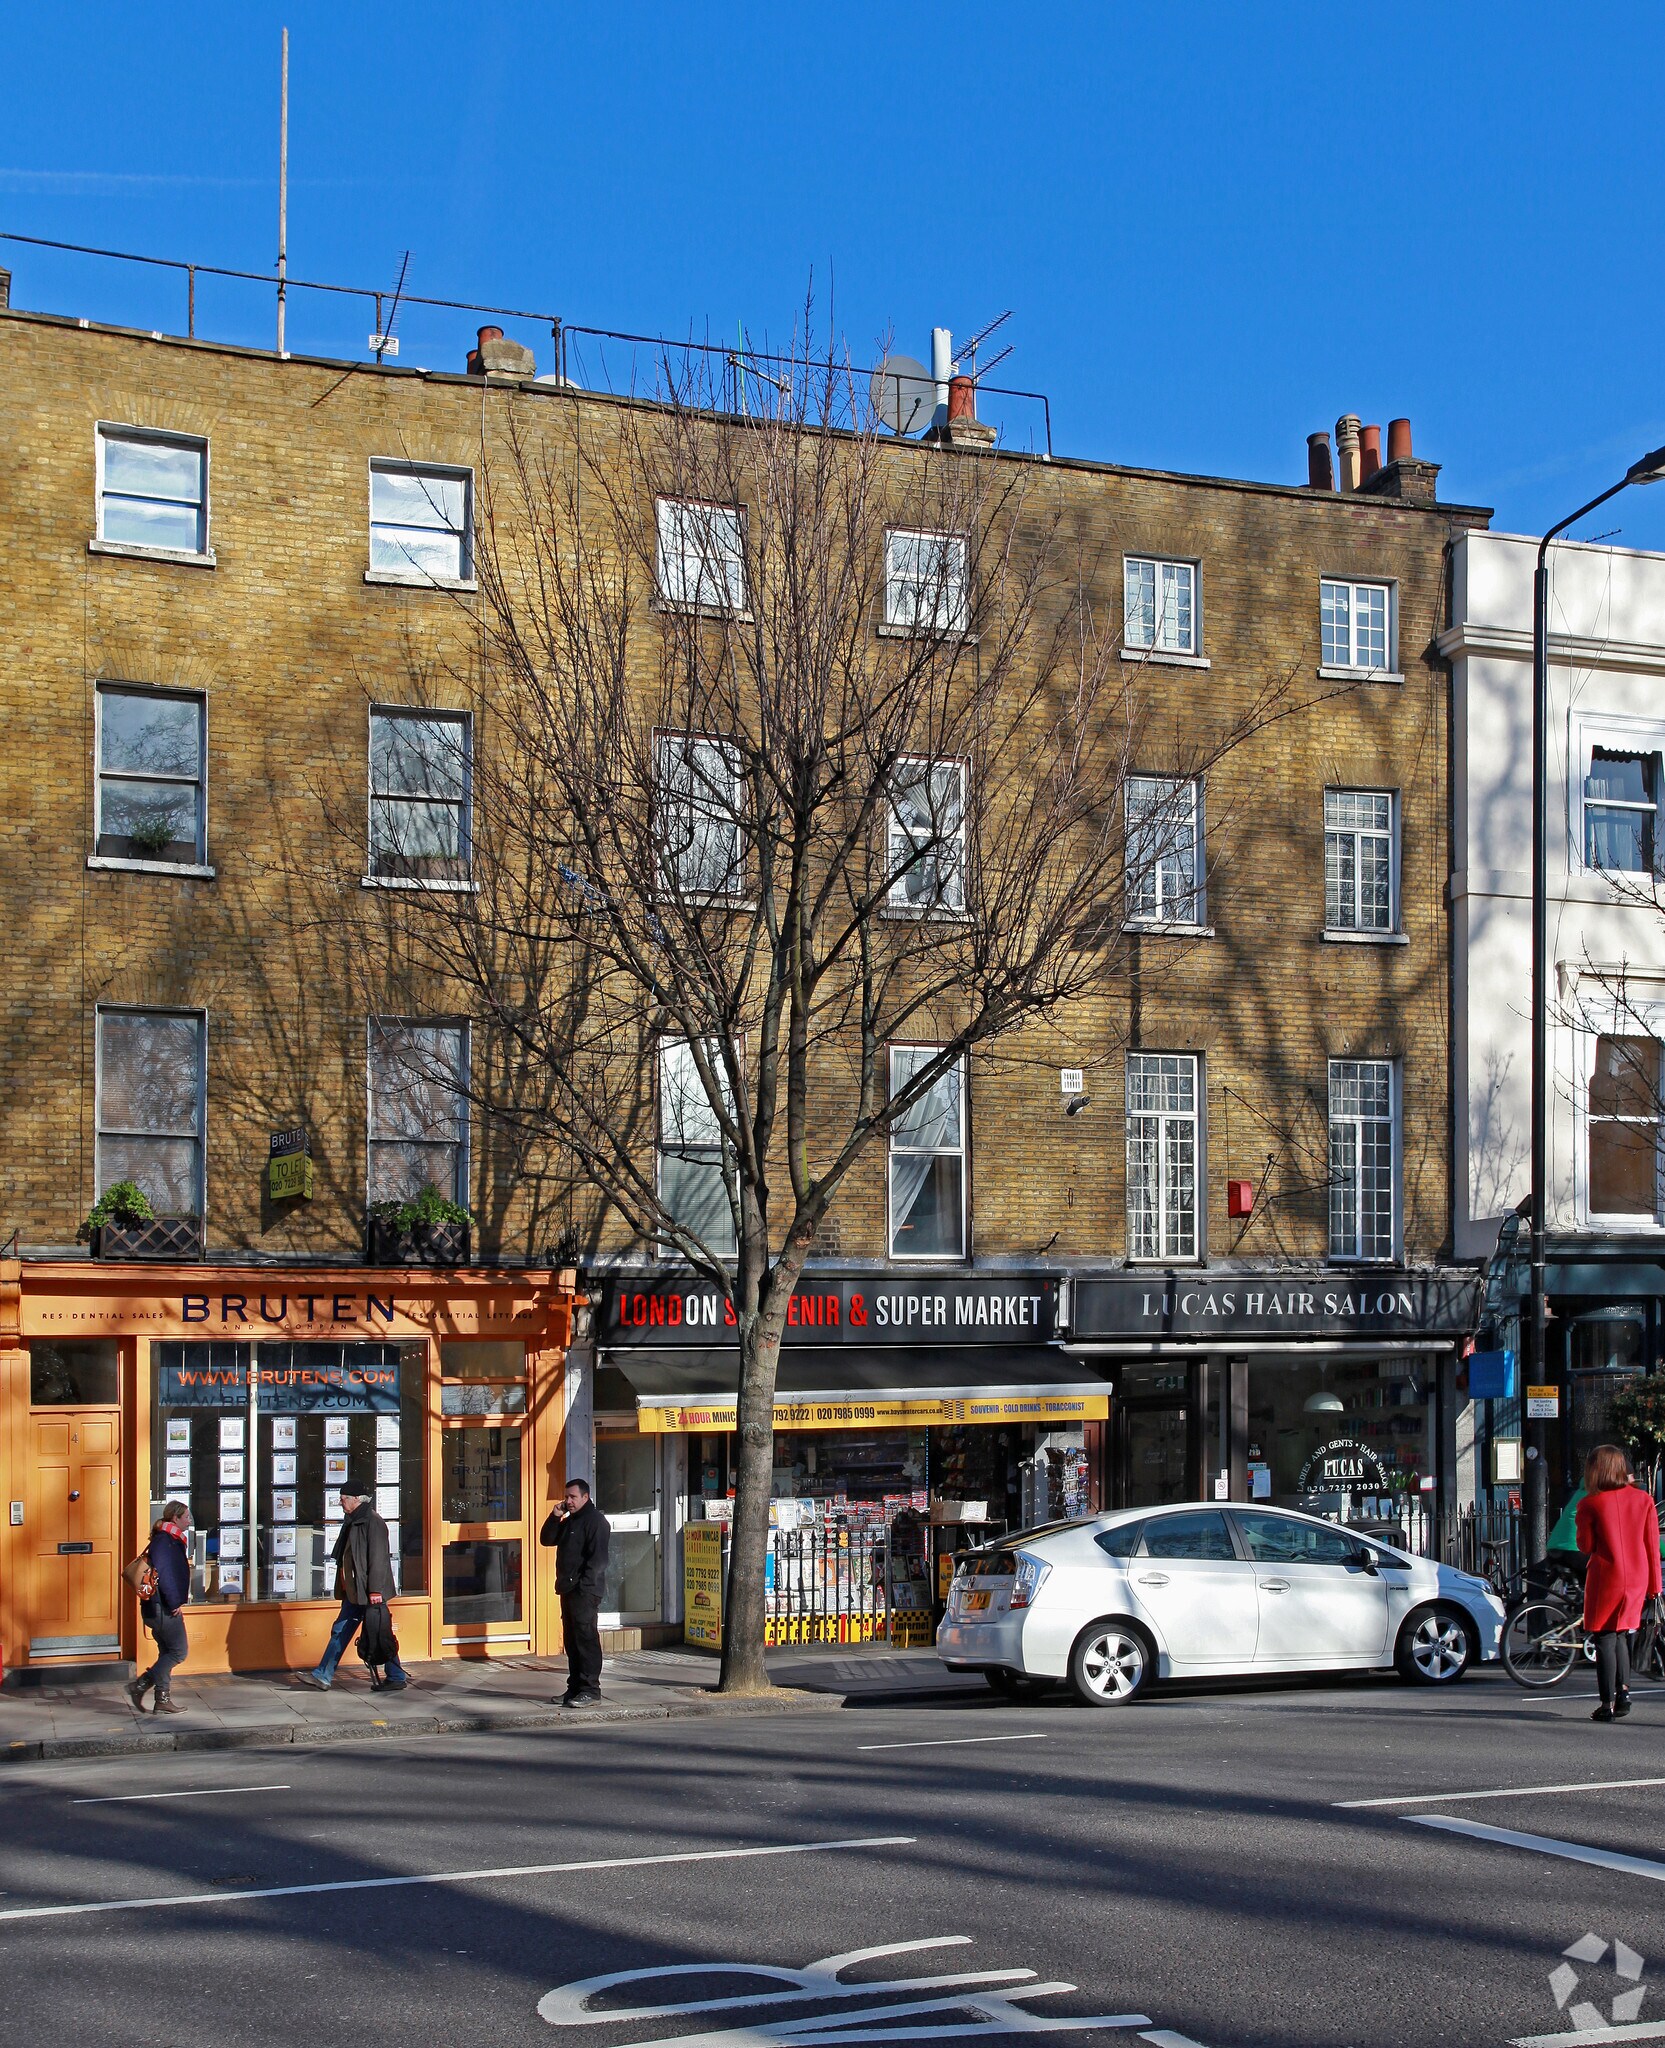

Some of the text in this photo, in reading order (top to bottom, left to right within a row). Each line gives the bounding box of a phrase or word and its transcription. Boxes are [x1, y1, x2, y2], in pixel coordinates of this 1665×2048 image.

[276, 1162, 288, 1178] TO
[181, 1294, 396, 1322] BRUTEN
[620, 1293, 1042, 1327] LONDON SENIR & SUPER MARKET
[1142, 1293, 1416, 1316] LUCAS HAIR SALON
[177, 1370, 395, 1386] WWW.BRUTENS.COM
[790, 1408, 810, 1421] 9222
[817, 1408, 832, 1420] 020
[834, 1408, 852, 1420] 7985
[854, 1406, 875, 1418] 0999
[970, 1402, 1085, 1414] SOUVENIR COLD DRINKS TOBACCONIST
[689, 1412, 712, 1424] HOUR
[712, 1410, 738, 1423] MINIC
[71, 1432, 79, 1444] 4
[1297, 1440, 1389, 1492] LADIES AND GENTS HAIR SALON
[1324, 1458, 1364, 1477] LUCAS
[686, 1567, 720, 1580] 020 7792 9222
[686, 1580, 720, 1592] 020 7985 0999
